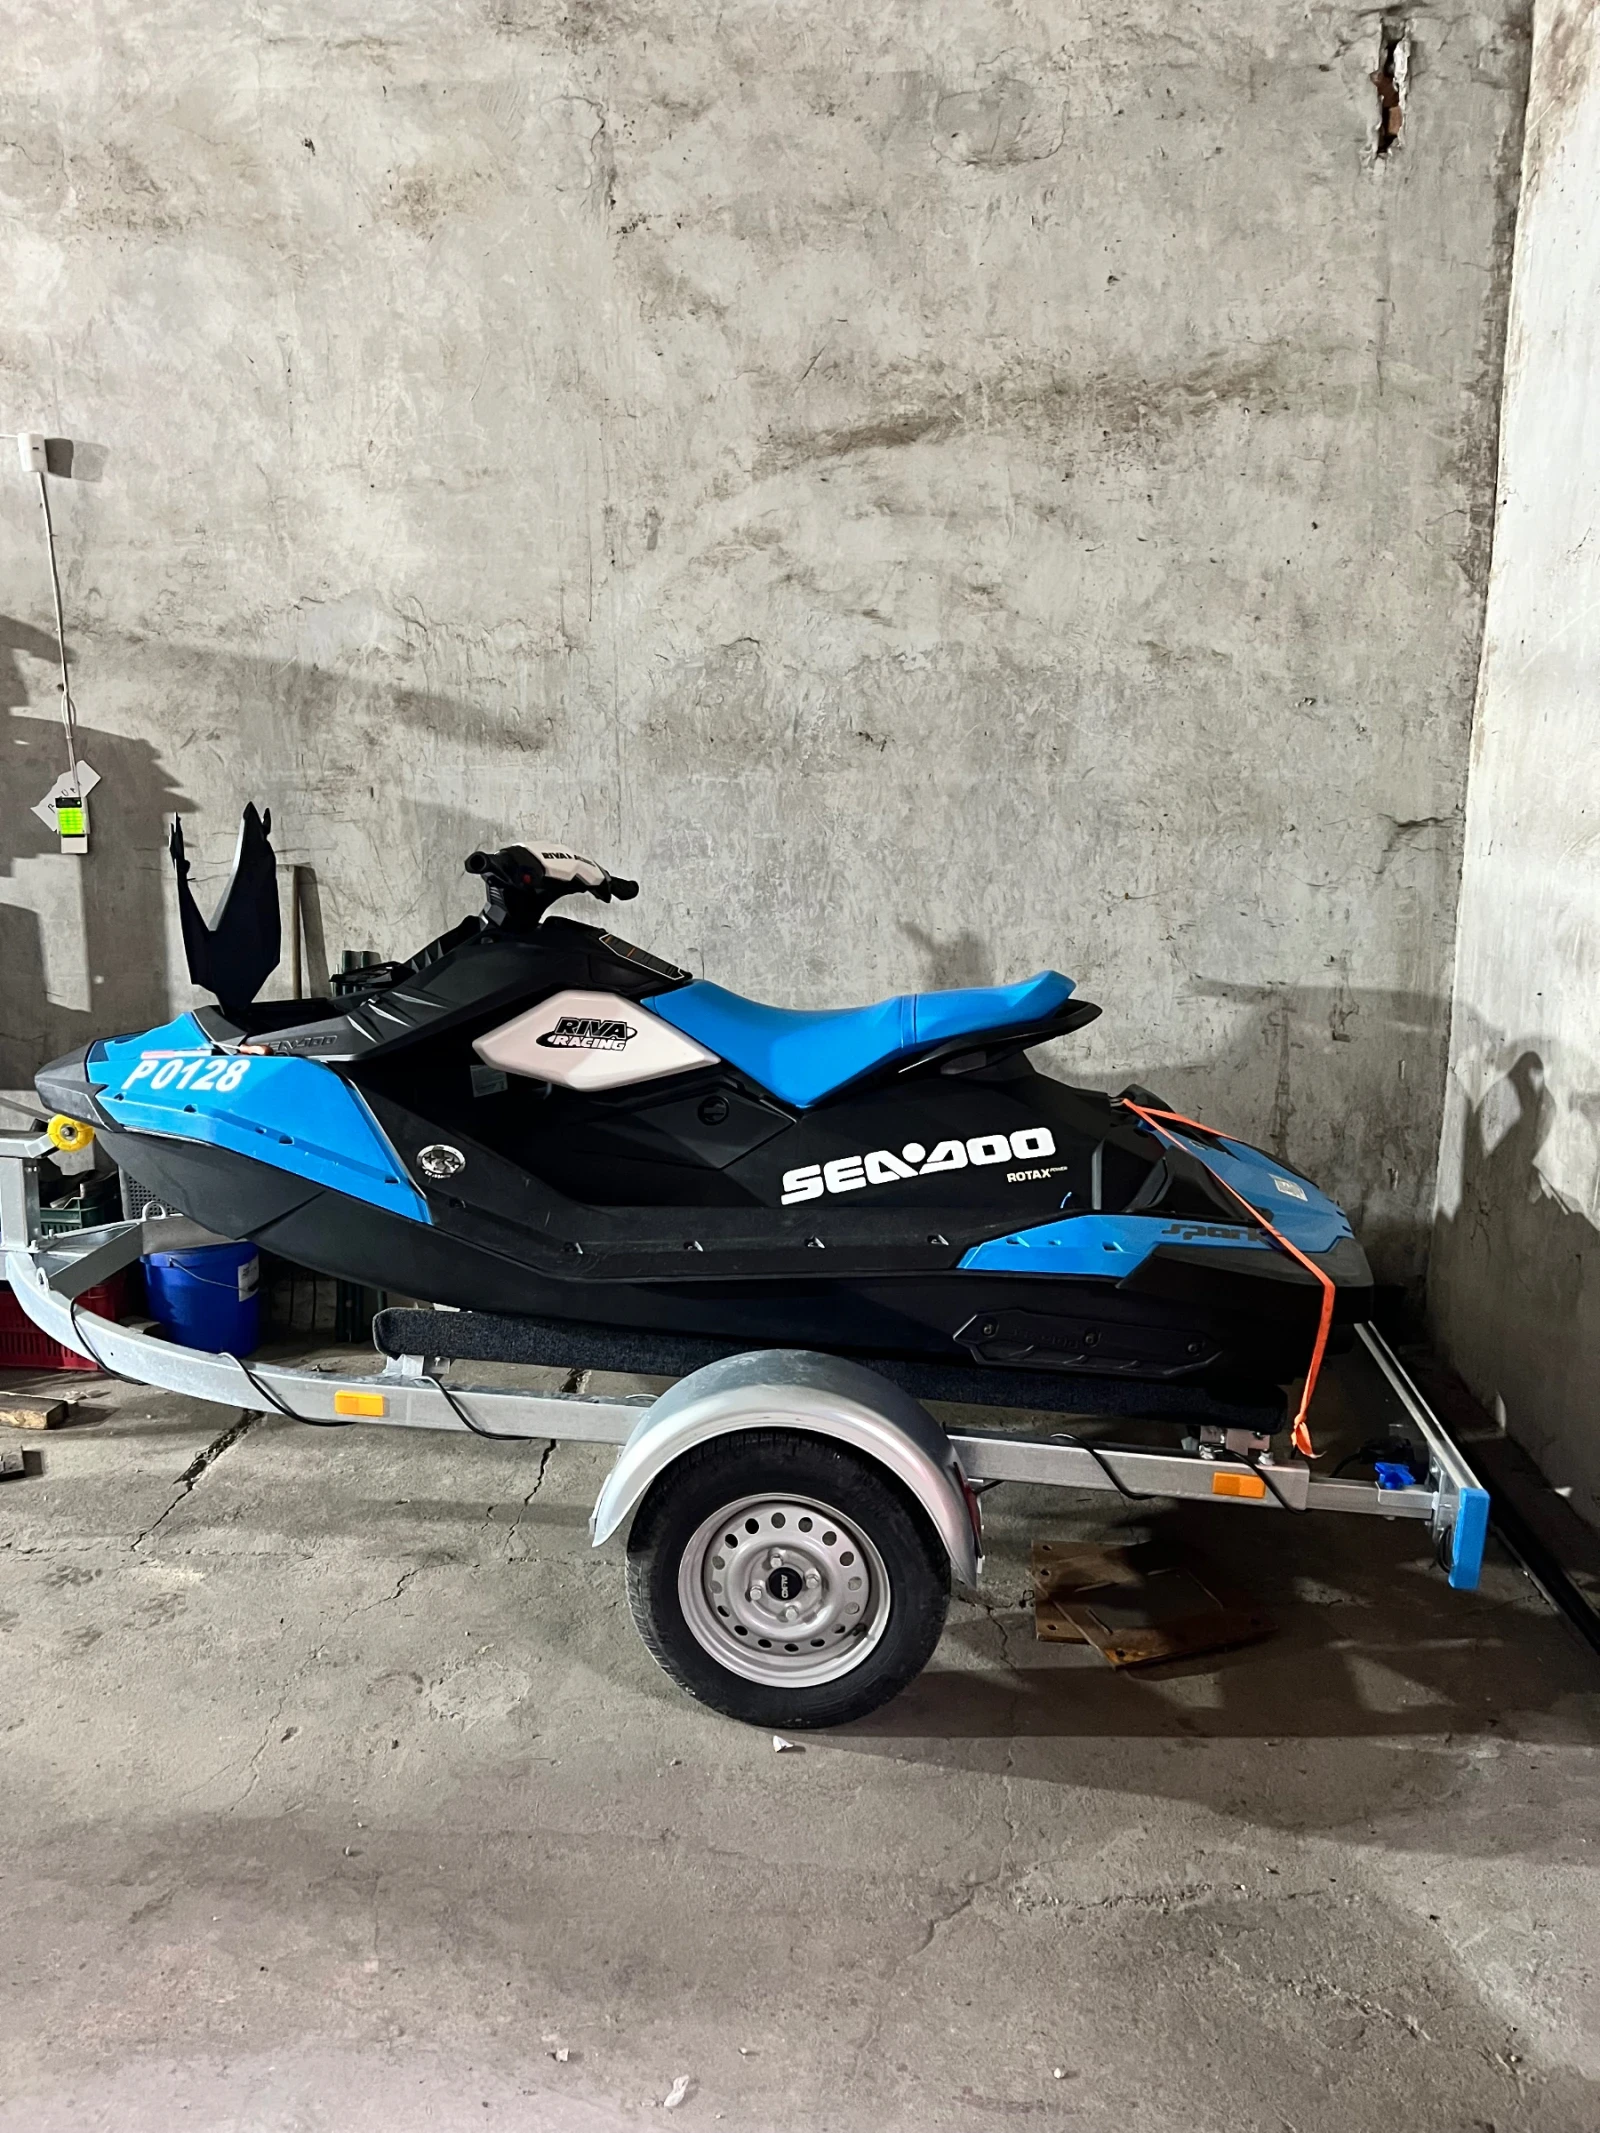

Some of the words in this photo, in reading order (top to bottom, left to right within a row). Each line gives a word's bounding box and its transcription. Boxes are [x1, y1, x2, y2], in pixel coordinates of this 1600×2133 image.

[555, 1017, 628, 1039] RIVA
[553, 1034, 626, 1051] RACING
[1006, 1168, 1051, 1183] ROTAX
